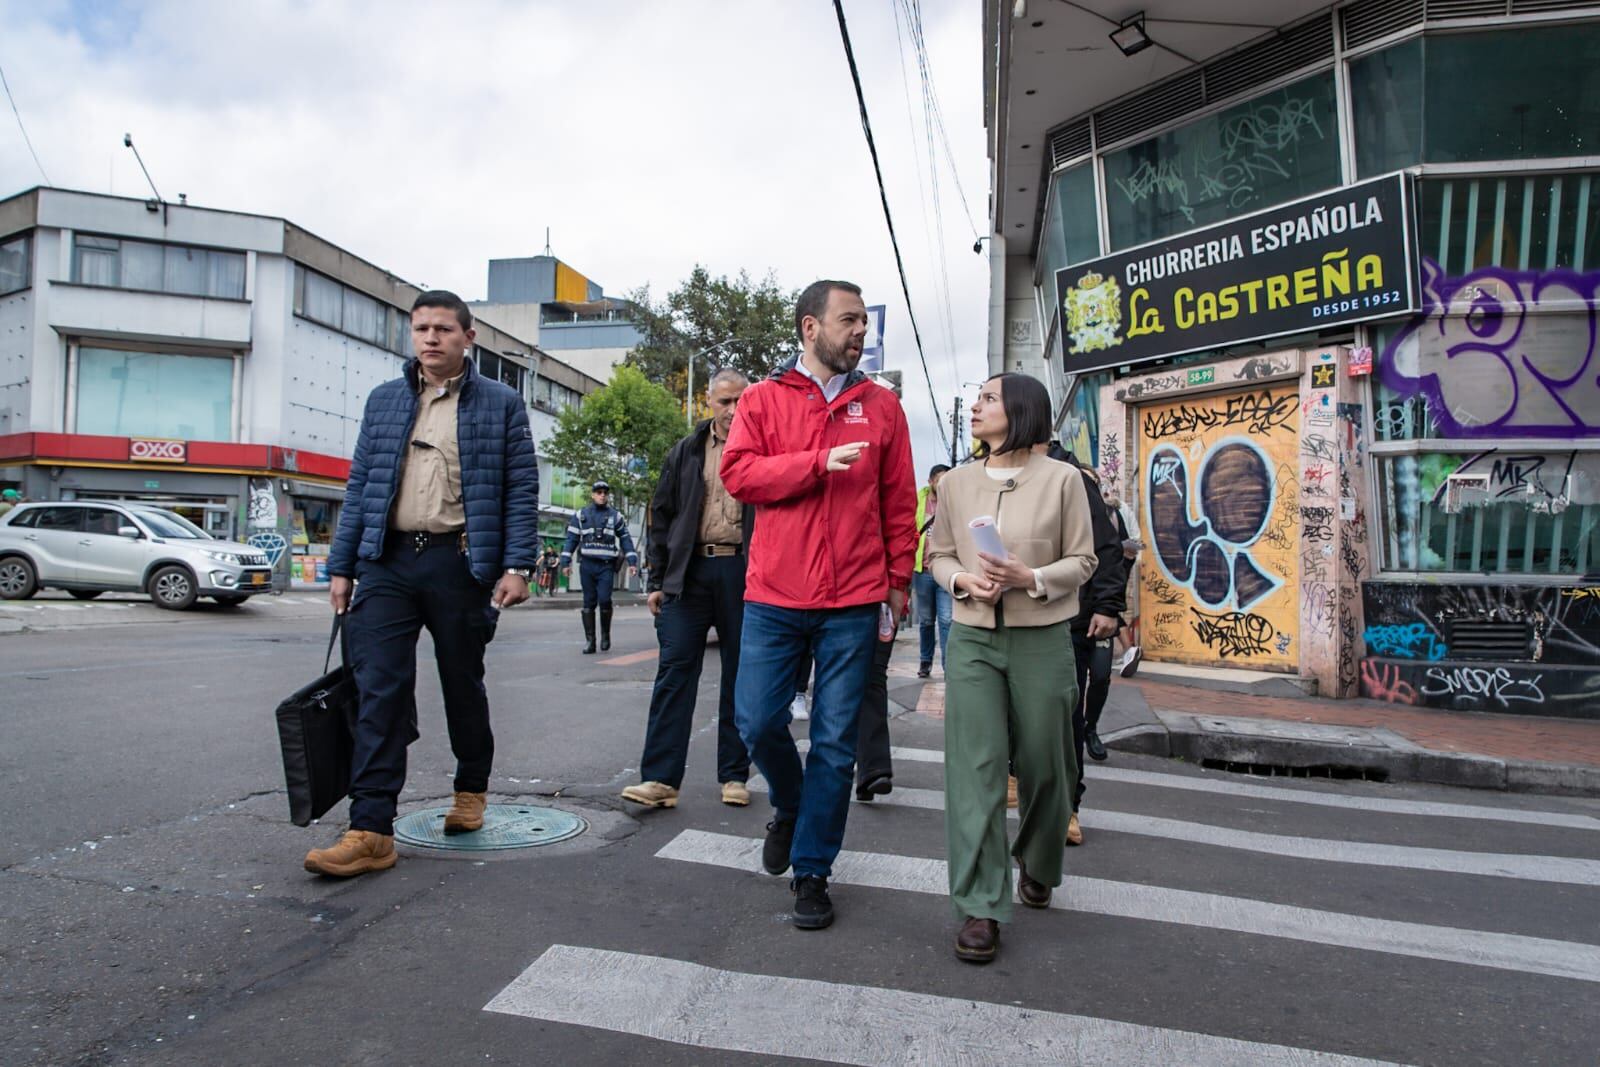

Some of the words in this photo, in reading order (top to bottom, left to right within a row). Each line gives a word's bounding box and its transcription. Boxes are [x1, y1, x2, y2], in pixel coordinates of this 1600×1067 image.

[1126, 234, 1244, 287] CHURRERIA
[1252, 197, 1383, 254] ESPAÑOLA
[1127, 288, 1165, 339] La
[1175, 247, 1384, 331] CASTREÑA
[1312, 297, 1359, 317] DESDE
[1364, 290, 1401, 308] 1952
[1190, 370, 1213, 383] 58-99
[131, 441, 185, 458] OXXO
